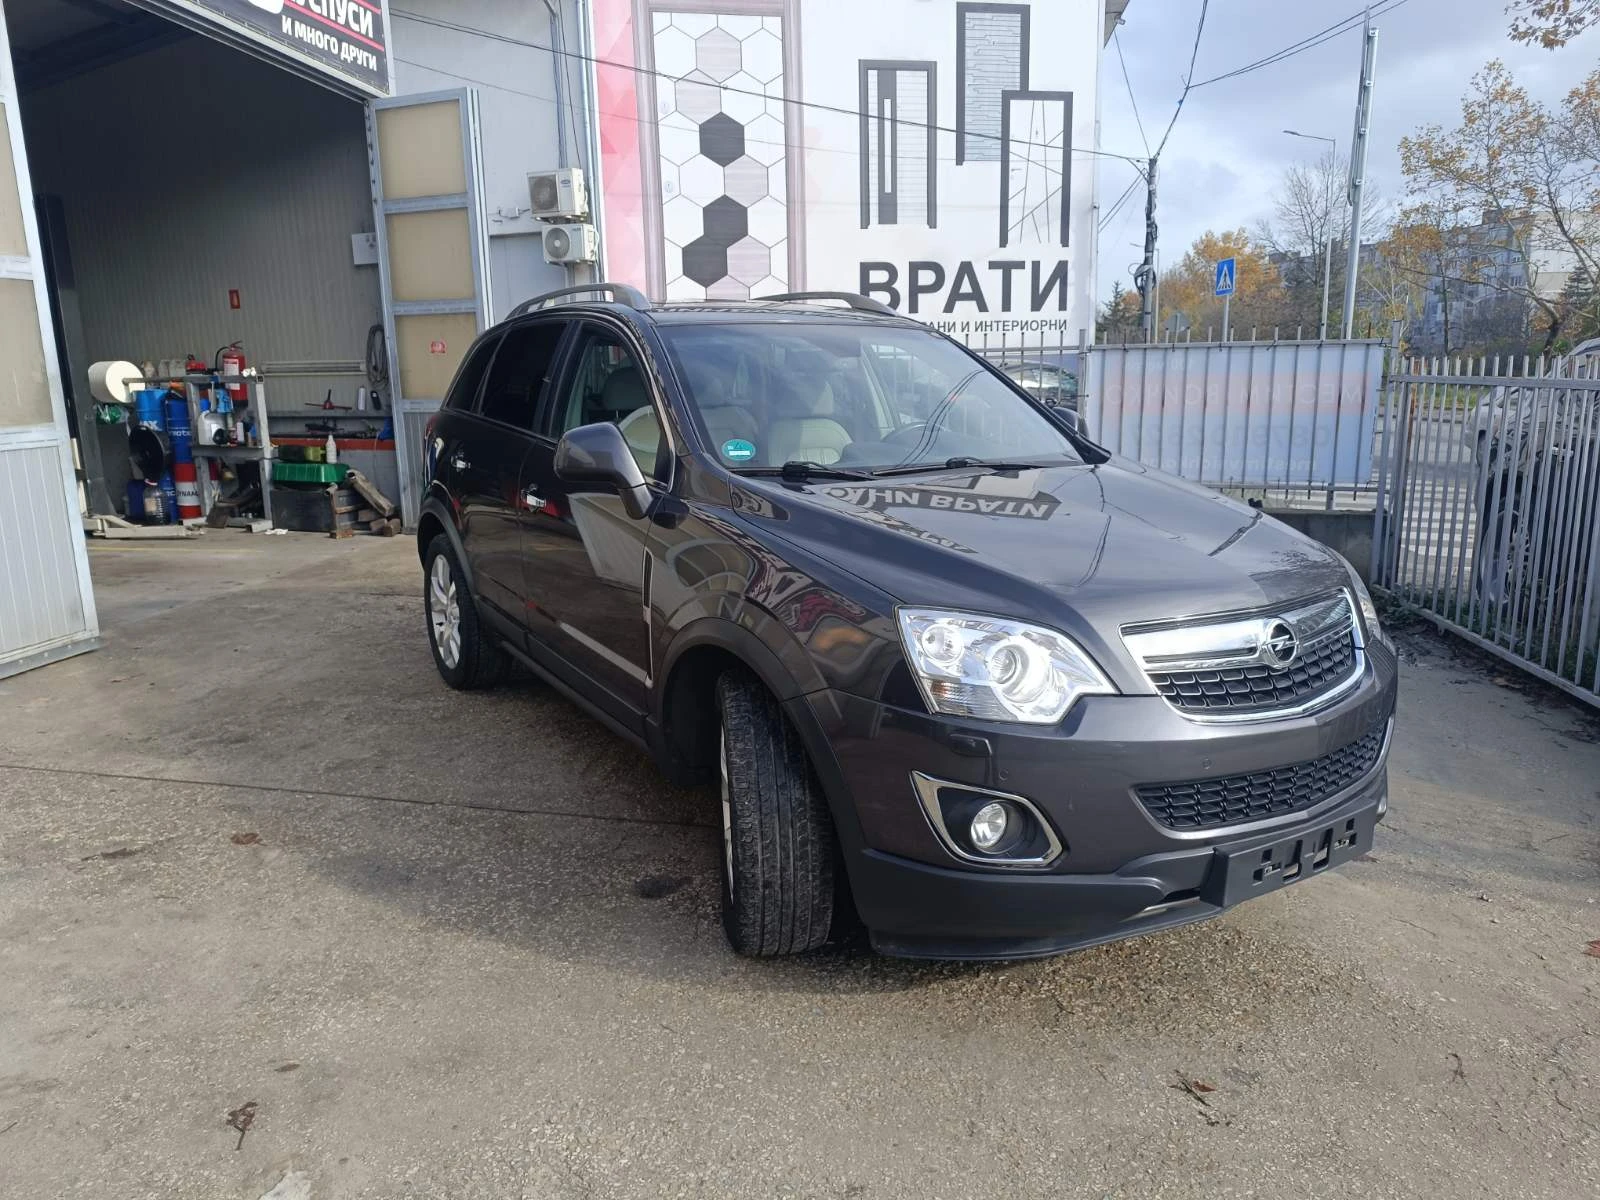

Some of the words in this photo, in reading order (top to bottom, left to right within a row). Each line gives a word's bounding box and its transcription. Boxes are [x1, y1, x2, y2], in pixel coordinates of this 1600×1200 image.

[282, 14, 292, 36] И
[294, 20, 338, 55] МНОГО
[341, 42, 377, 71] ДРУГИ
[293, 0, 373, 39] СПУСИ
[859, 259, 1069, 314] ВРАТИ
[961, 321, 970, 333] И
[974, 319, 1067, 332] ИНТЕРИОРНИ
